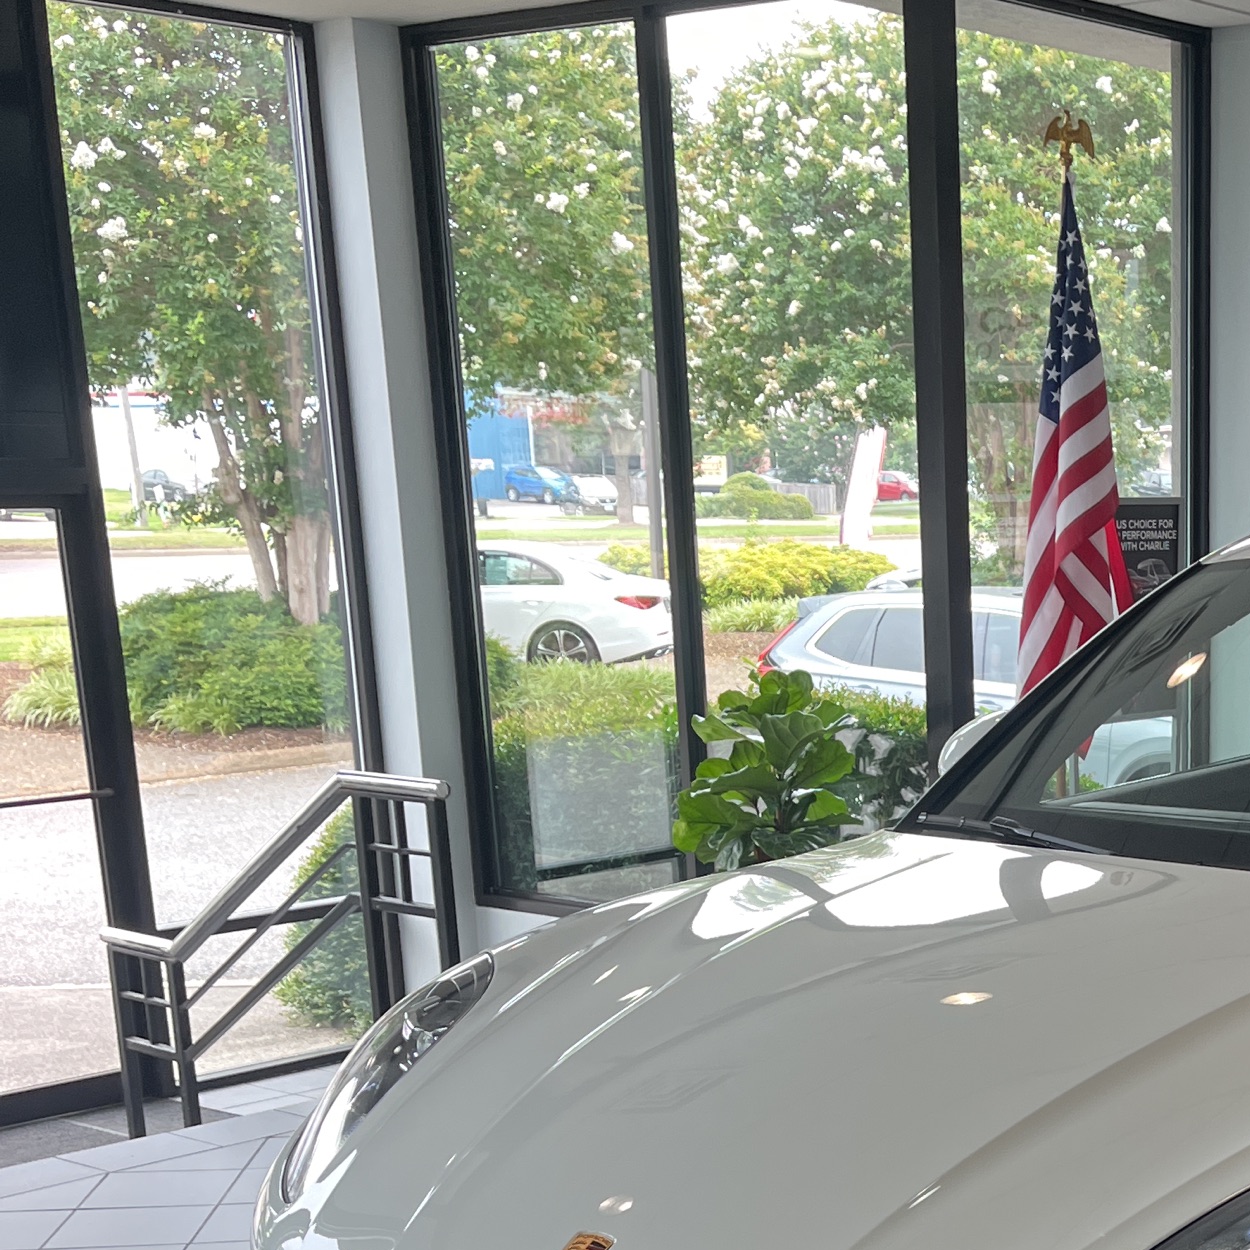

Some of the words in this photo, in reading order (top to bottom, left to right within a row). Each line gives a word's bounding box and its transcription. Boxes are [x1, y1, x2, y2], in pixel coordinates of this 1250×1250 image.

[1128, 520, 1157, 529] CHOICE
[1159, 519, 1174, 528] FOR
[1121, 530, 1177, 539] PERFORMANCE
[1139, 541, 1170, 551] CHARLIE
